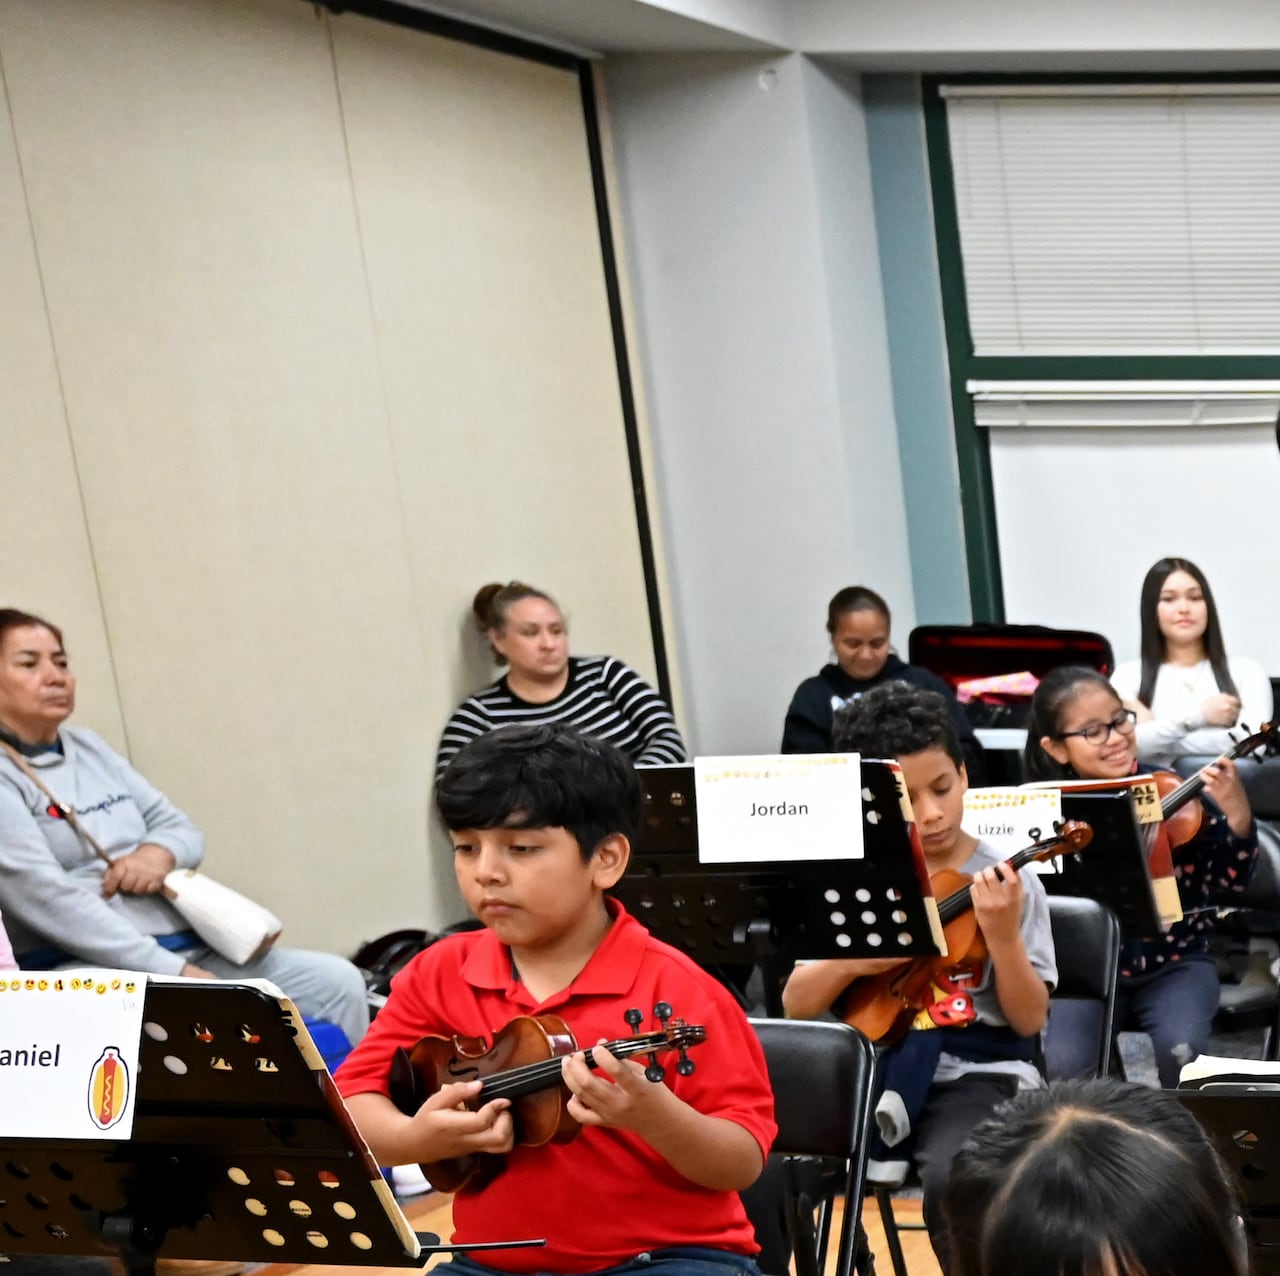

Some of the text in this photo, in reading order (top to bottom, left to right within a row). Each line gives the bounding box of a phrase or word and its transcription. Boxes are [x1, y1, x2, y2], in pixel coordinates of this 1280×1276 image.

[750, 802, 809, 817] Jordan
[977, 823, 1015, 836] Lizzie
[0, 1044, 61, 1068] aniel
